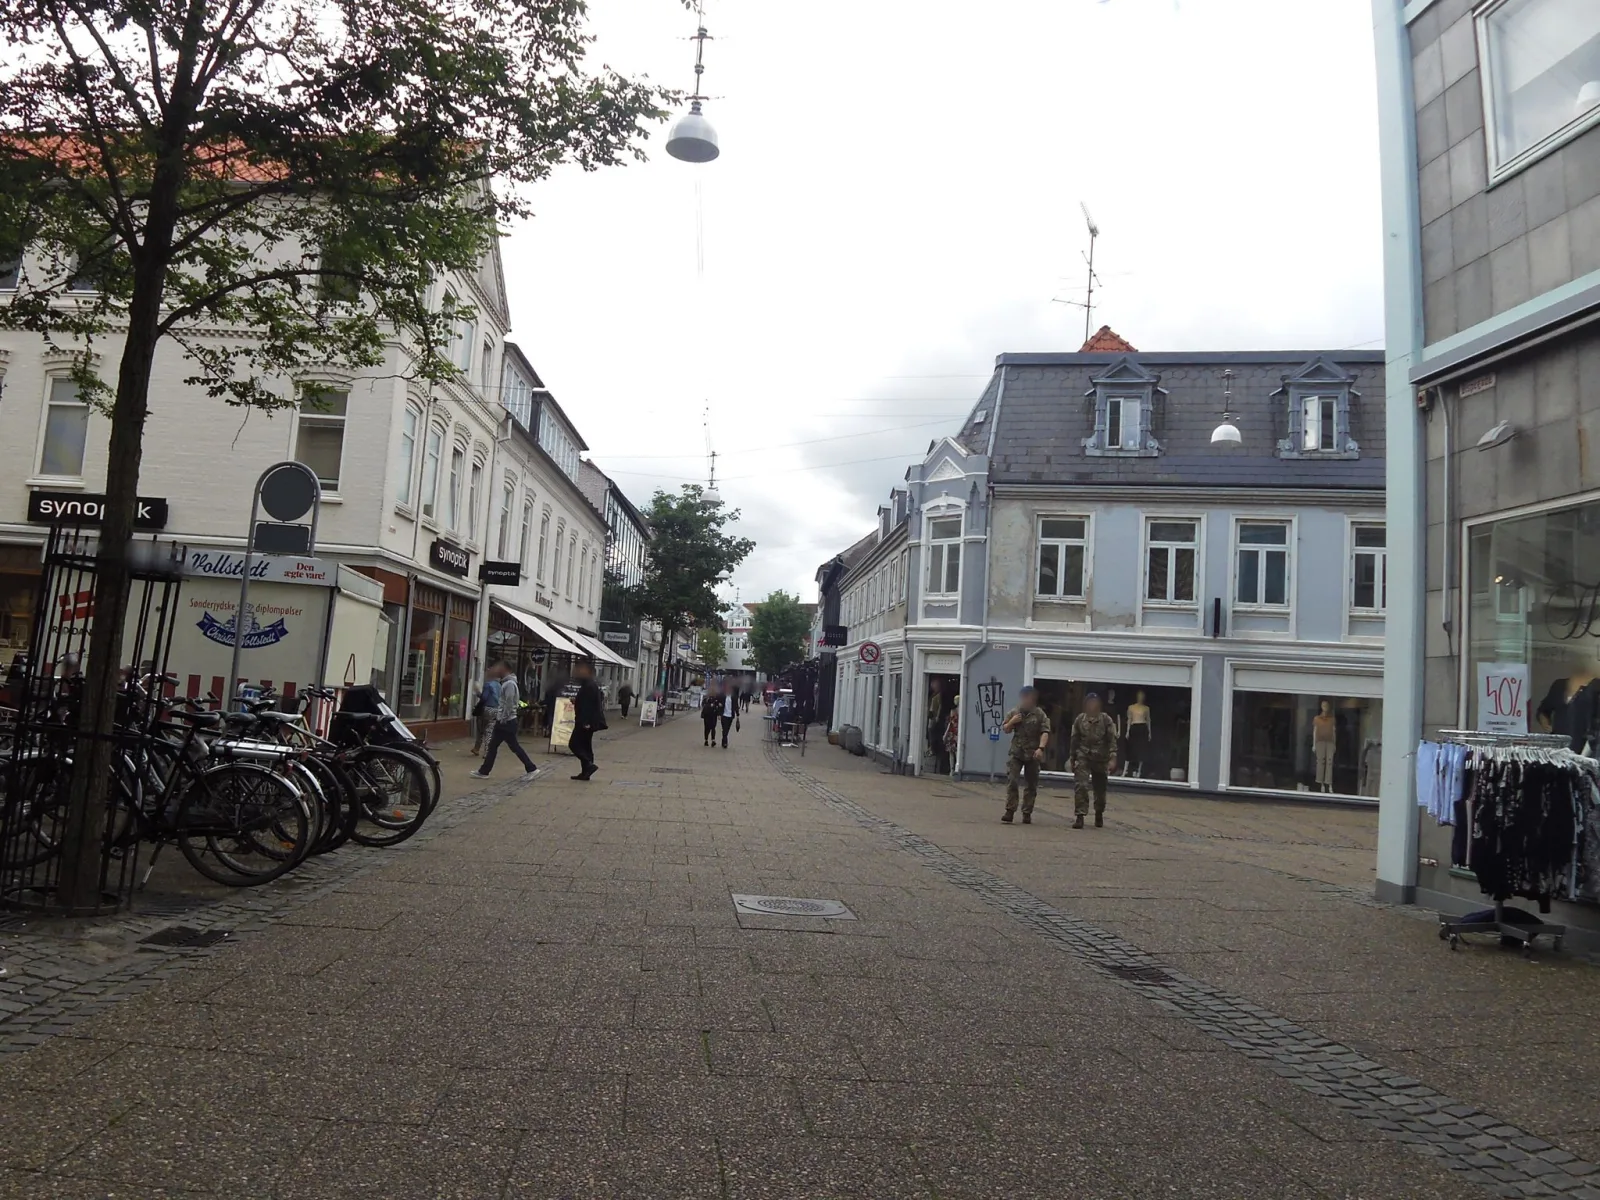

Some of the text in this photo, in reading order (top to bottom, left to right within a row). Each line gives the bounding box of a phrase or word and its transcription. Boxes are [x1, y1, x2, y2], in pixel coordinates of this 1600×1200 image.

[39, 499, 152, 520] synok
[296, 562, 315, 572] Den
[438, 546, 468, 569] synoptik
[283, 570, 326, 580] ægte vare!
[189, 598, 303, 617] Sønderjydske diplompølser
[1486, 676, 1522, 717] 50%
